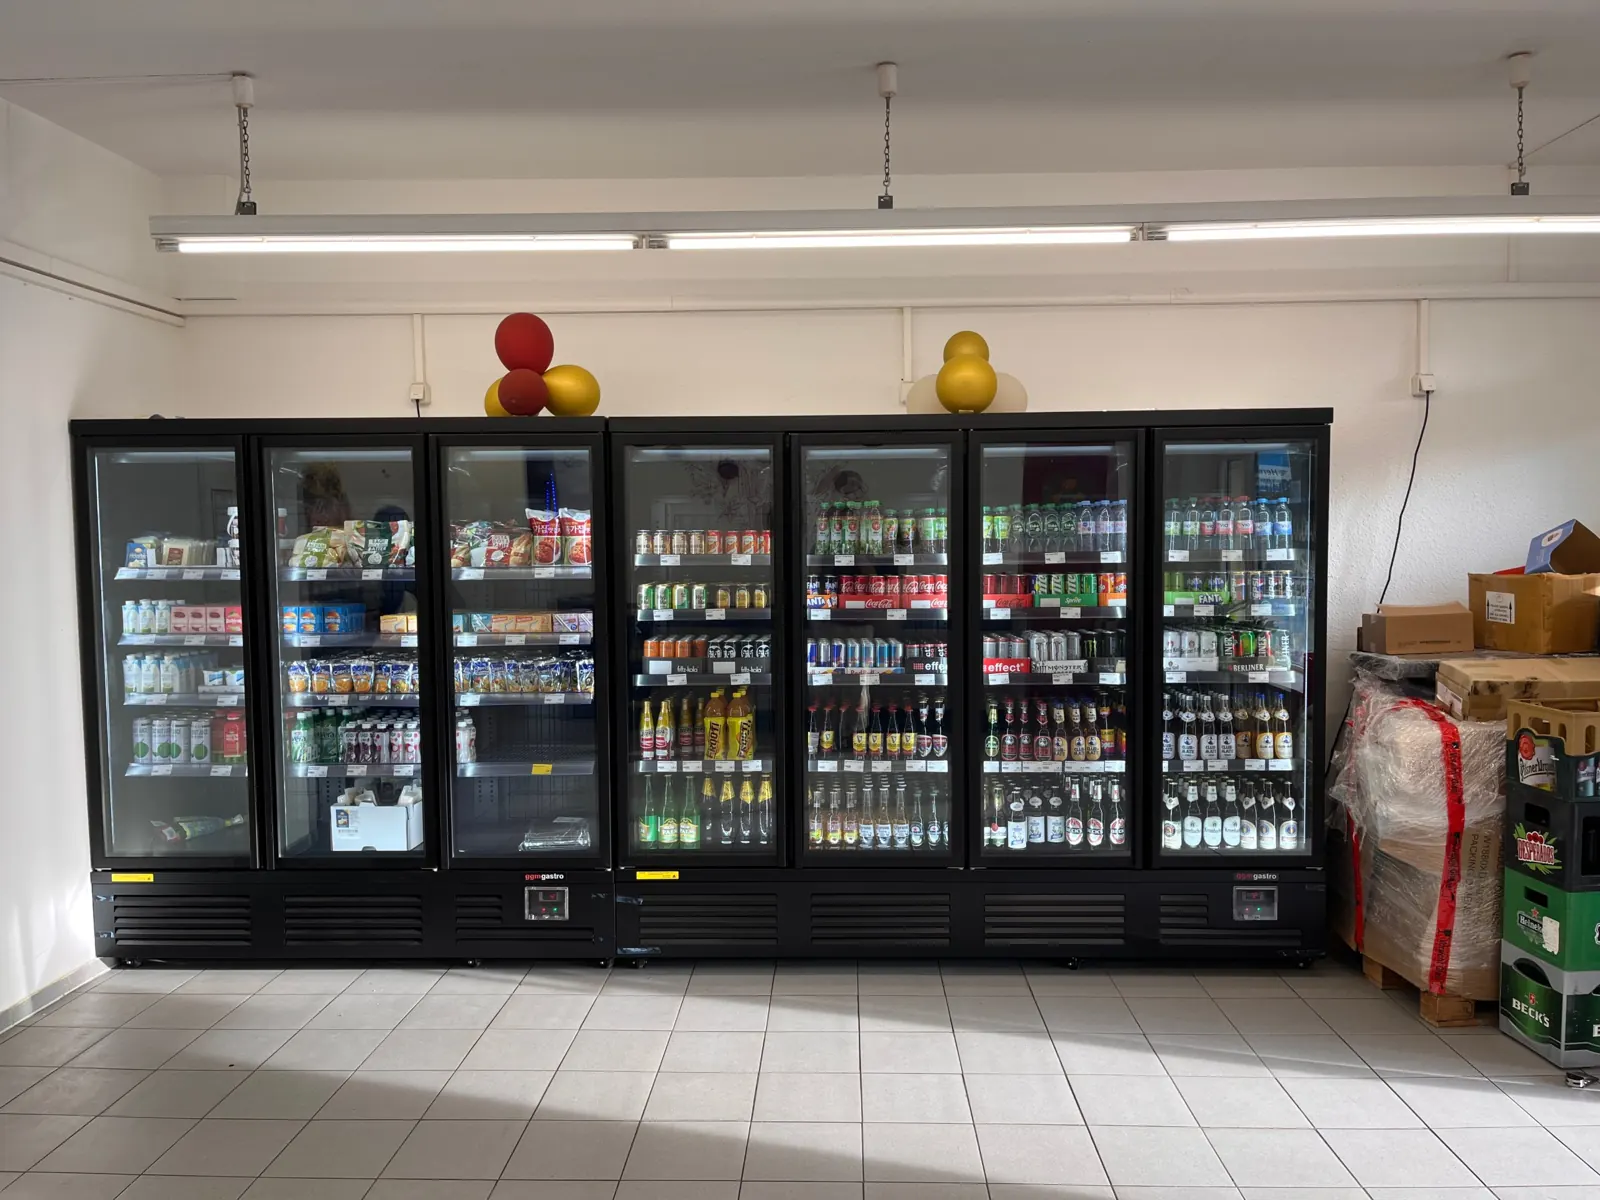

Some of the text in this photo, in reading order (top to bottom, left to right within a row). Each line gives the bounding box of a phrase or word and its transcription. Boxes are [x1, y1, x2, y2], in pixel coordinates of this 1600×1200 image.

[807, 599, 826, 609] ANTA
[1199, 594, 1223, 604] FANTA
[925, 661, 947, 671] effe
[988, 663, 1021, 672] effect
[1518, 840, 1554, 863] DESPERADOS
[1519, 914, 1543, 931] Heinek
[1512, 998, 1550, 1028] BECK'S
